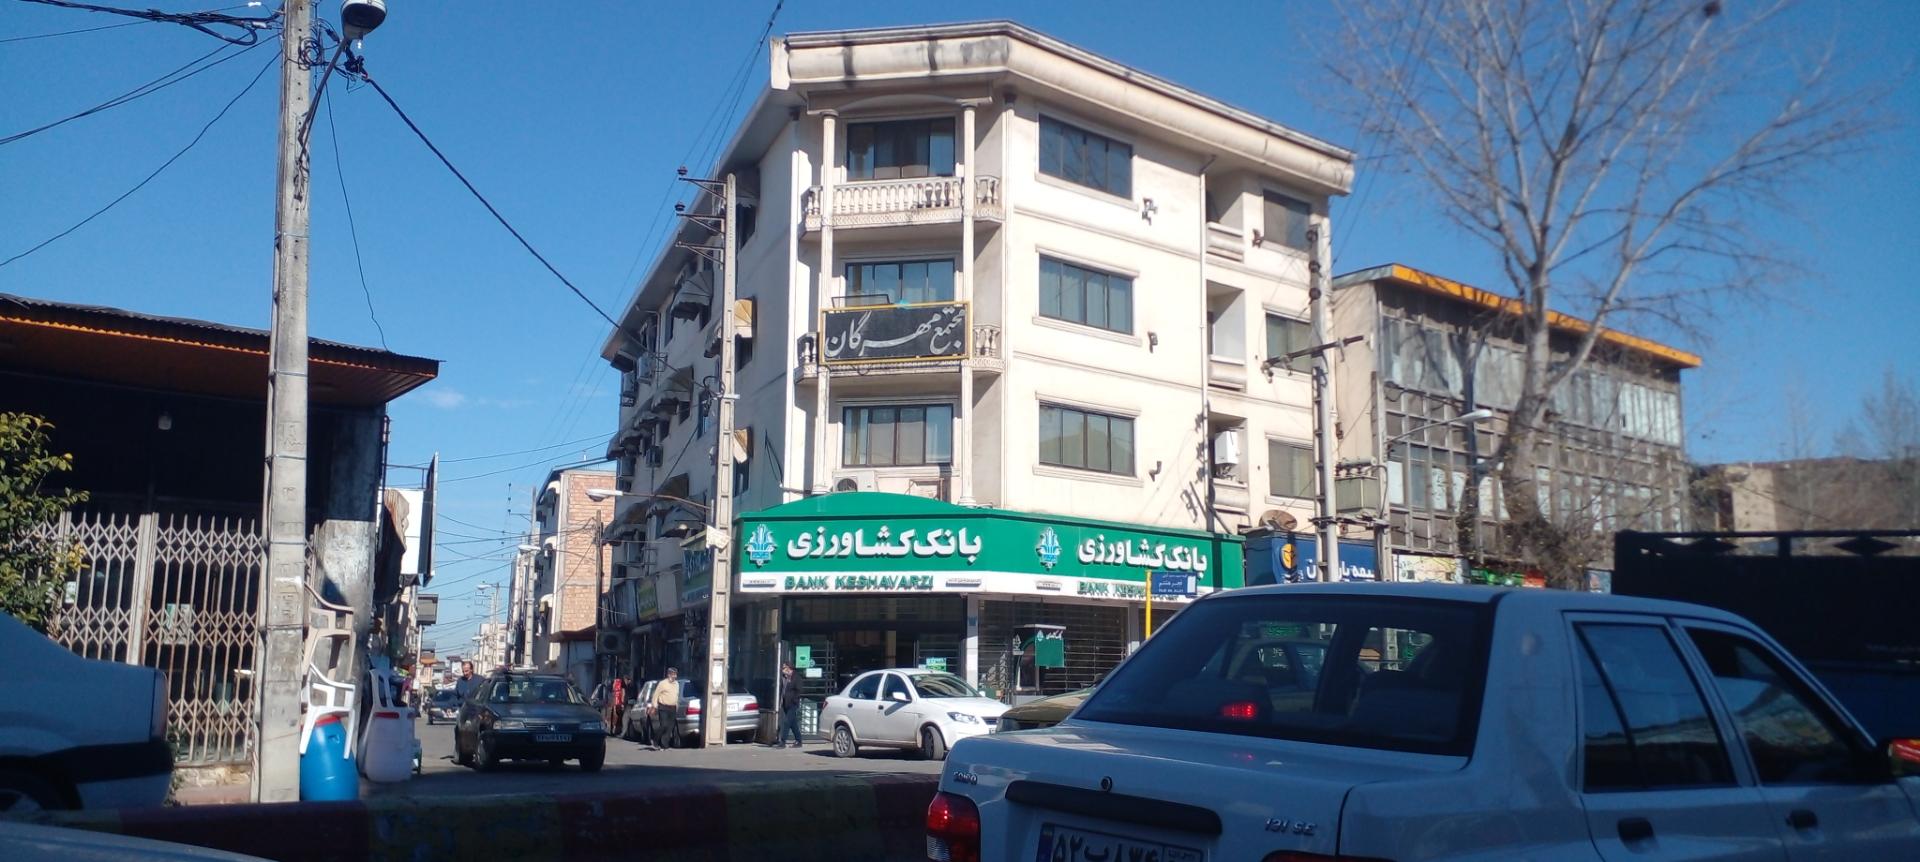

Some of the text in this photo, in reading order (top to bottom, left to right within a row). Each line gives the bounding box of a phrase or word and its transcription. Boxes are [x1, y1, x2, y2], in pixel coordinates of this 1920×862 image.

[825, 306, 967, 357] مجتمع مهرگان
[787, 525, 982, 564] بانک کشاورزی
[1079, 534, 1208, 579] بانک کشاورزی
[784, 574, 934, 591] BANK KESHAVARZI
[1078, 580, 1111, 596] BANK
